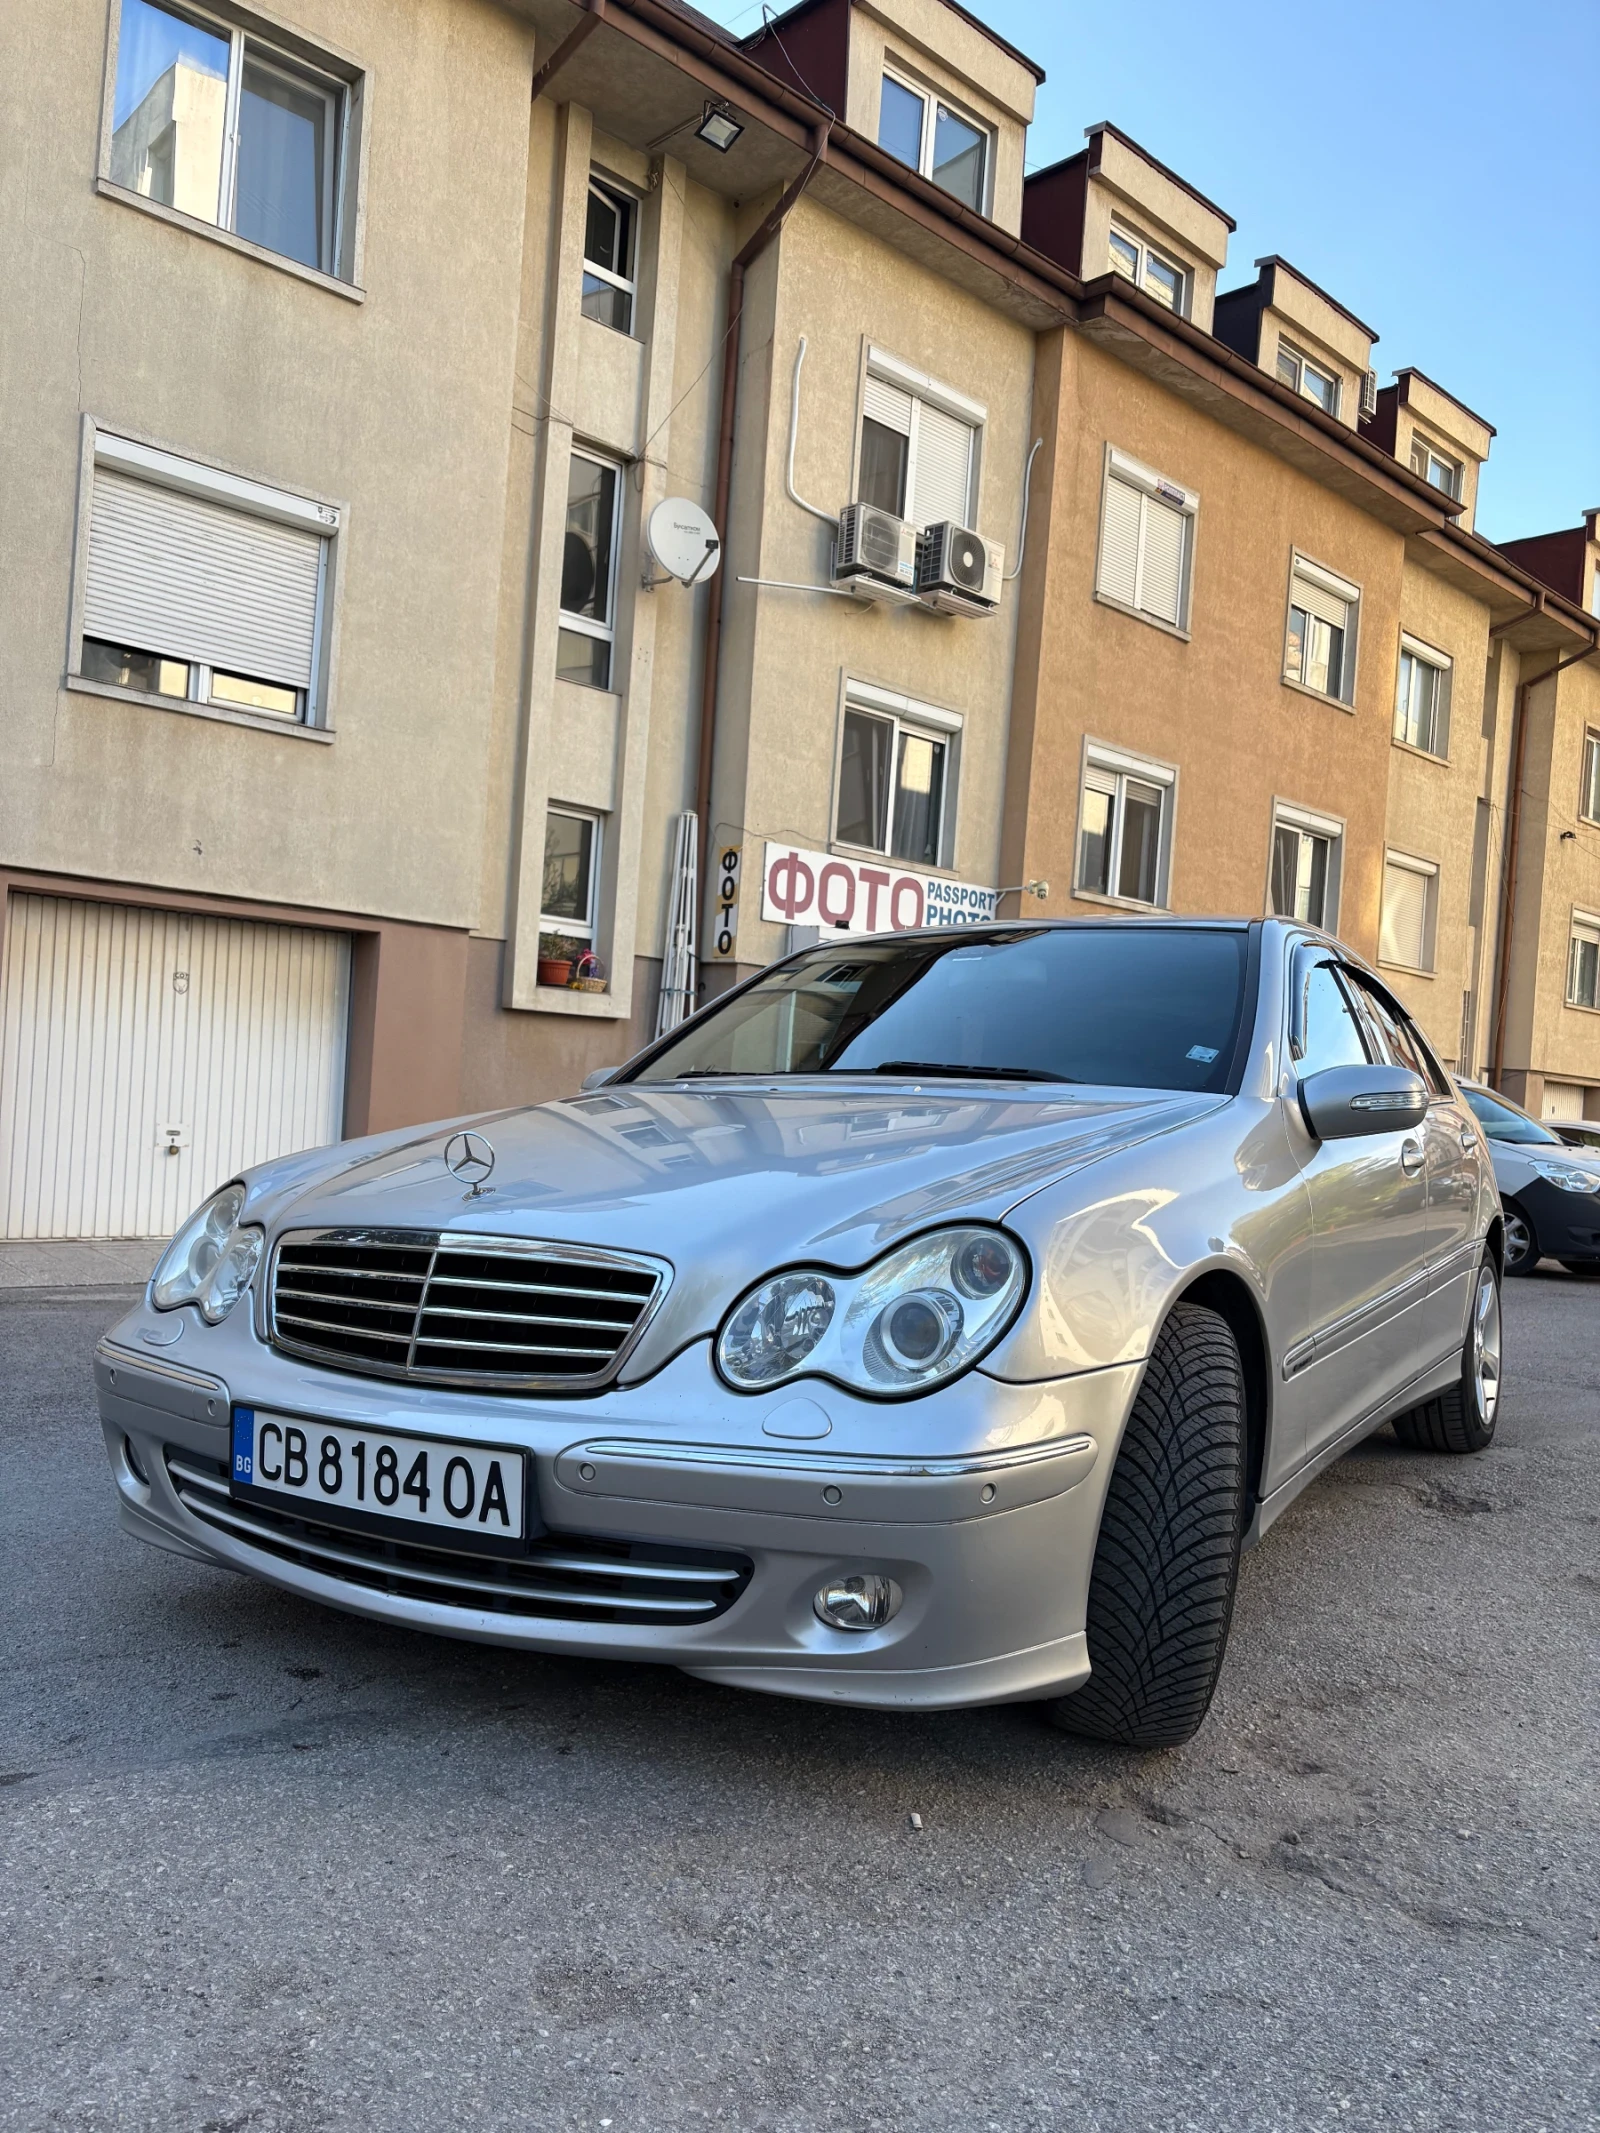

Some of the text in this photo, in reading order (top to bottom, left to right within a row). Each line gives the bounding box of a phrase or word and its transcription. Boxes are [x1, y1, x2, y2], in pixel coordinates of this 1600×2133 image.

[720, 848, 738, 955] ФОТО
[769, 852, 924, 931] ФОТО
[927, 881, 995, 911] PASSPORT
[235, 1454, 252, 1474] BG
